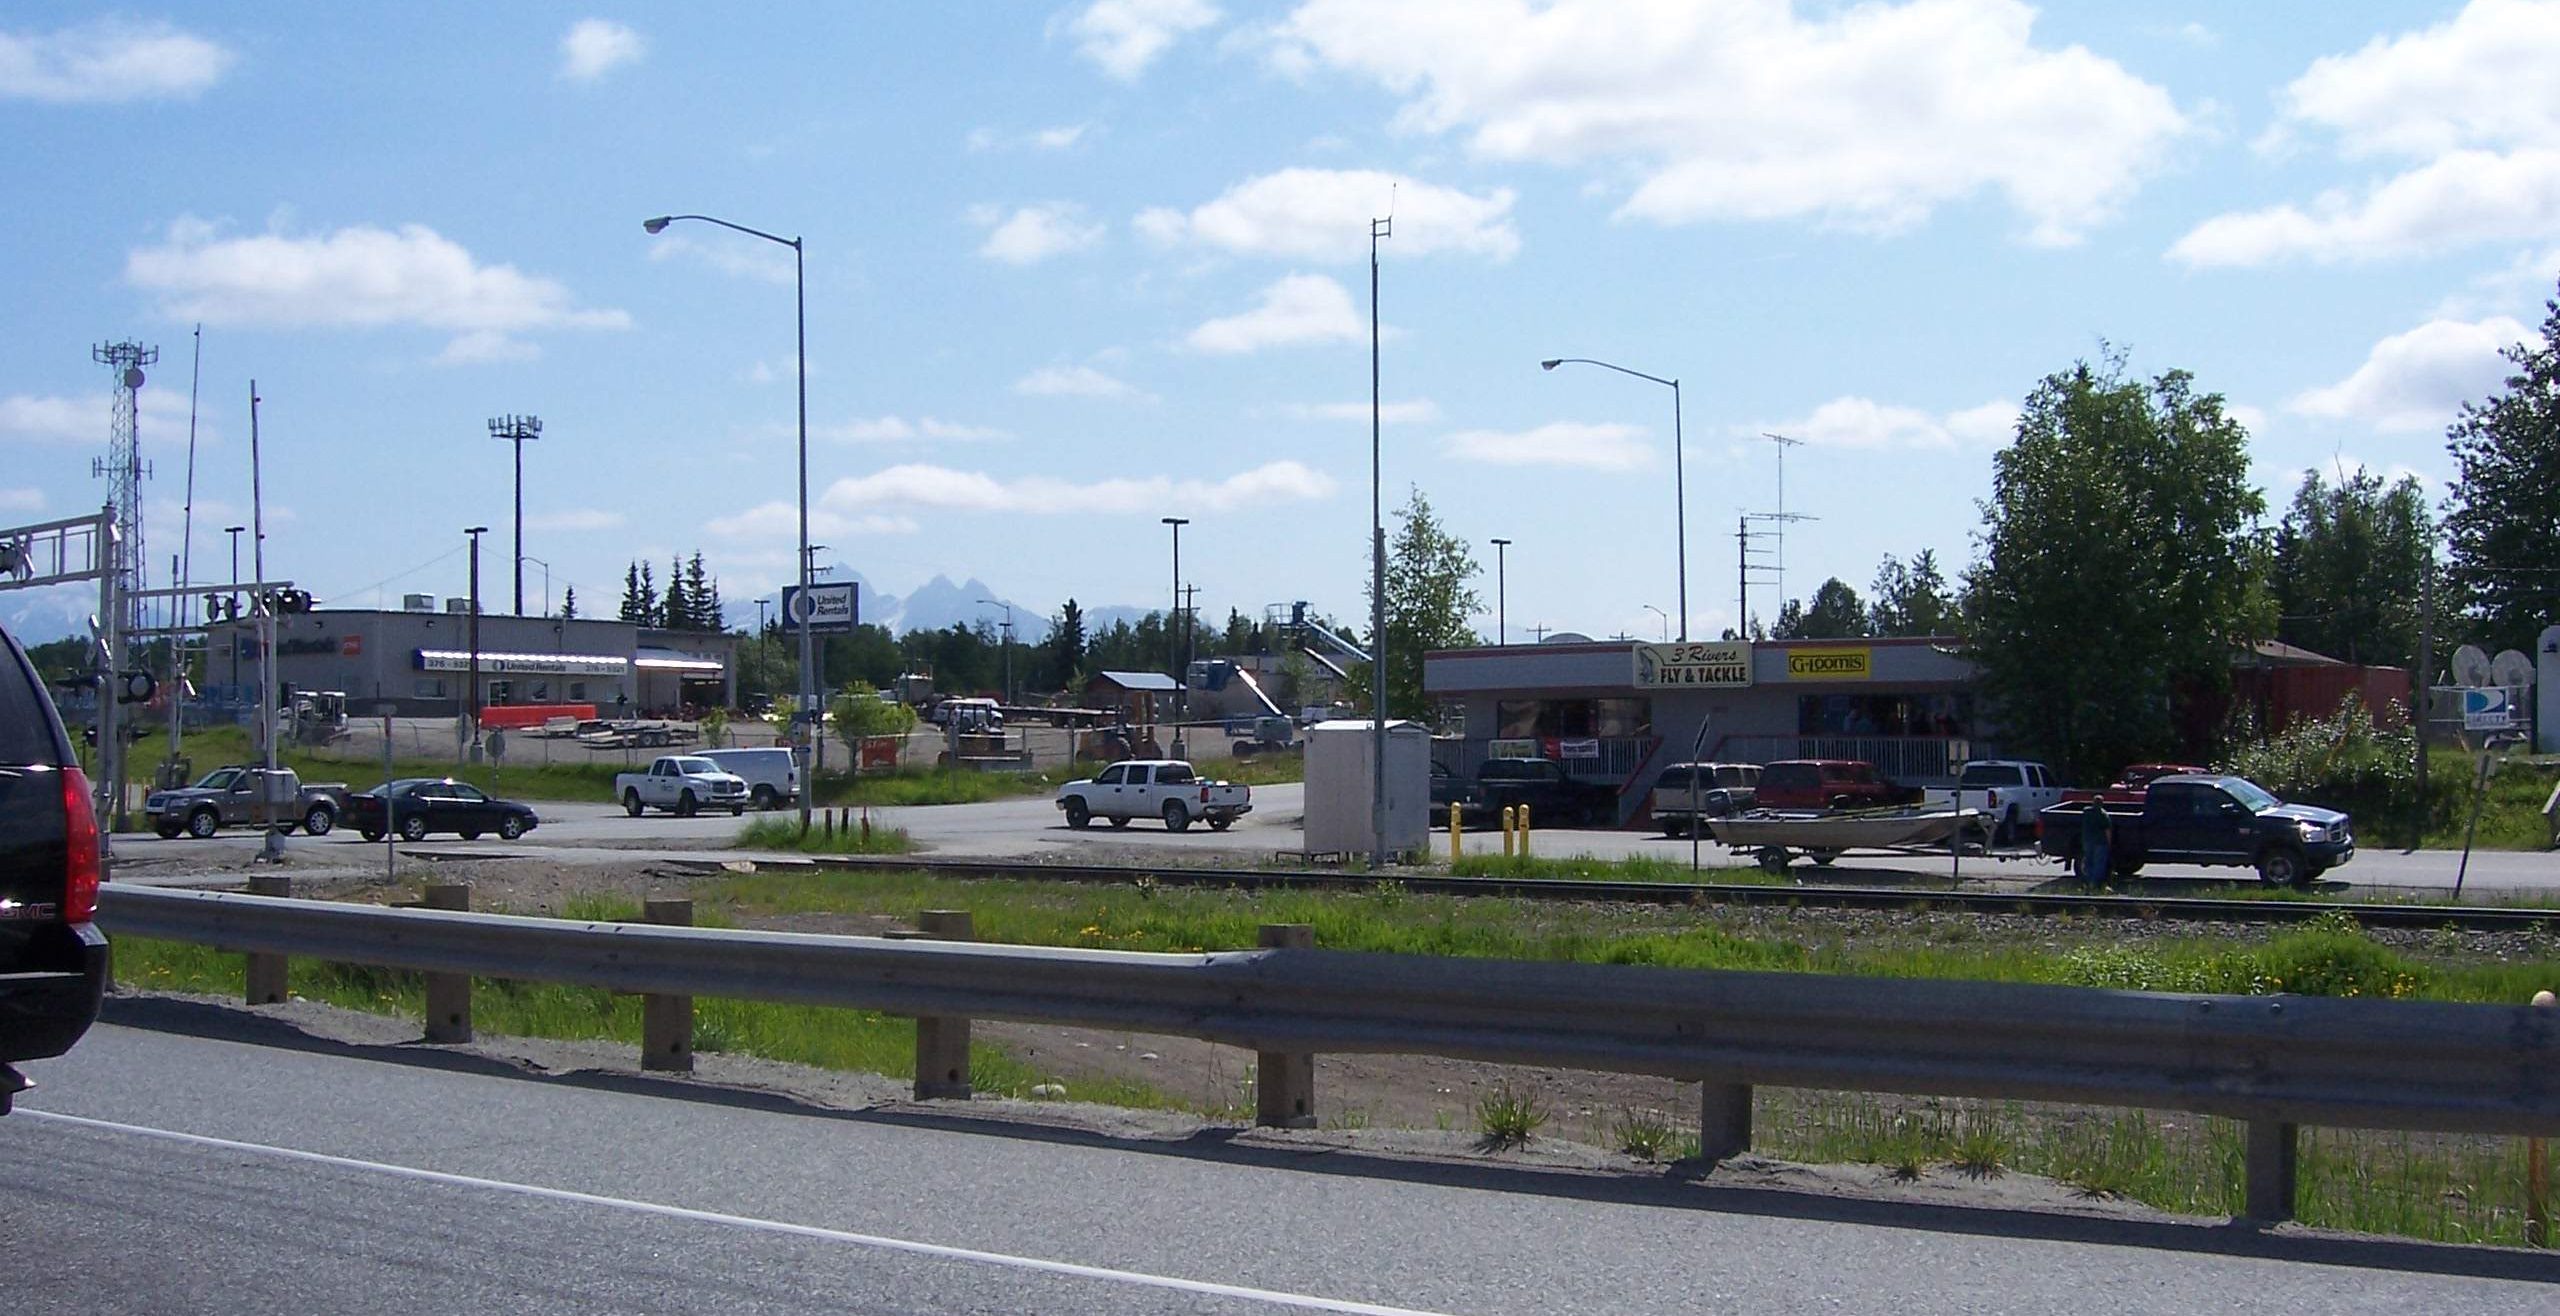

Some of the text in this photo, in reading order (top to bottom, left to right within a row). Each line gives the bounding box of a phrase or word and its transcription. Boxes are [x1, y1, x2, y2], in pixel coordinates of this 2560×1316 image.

[816, 593, 847, 605] United
[816, 605, 849, 616] Rentals
[1671, 645, 1737, 662] 3 Rivers
[1660, 666, 1746, 684] FLY & TACKLE
[1, 902, 56, 920] GMC
